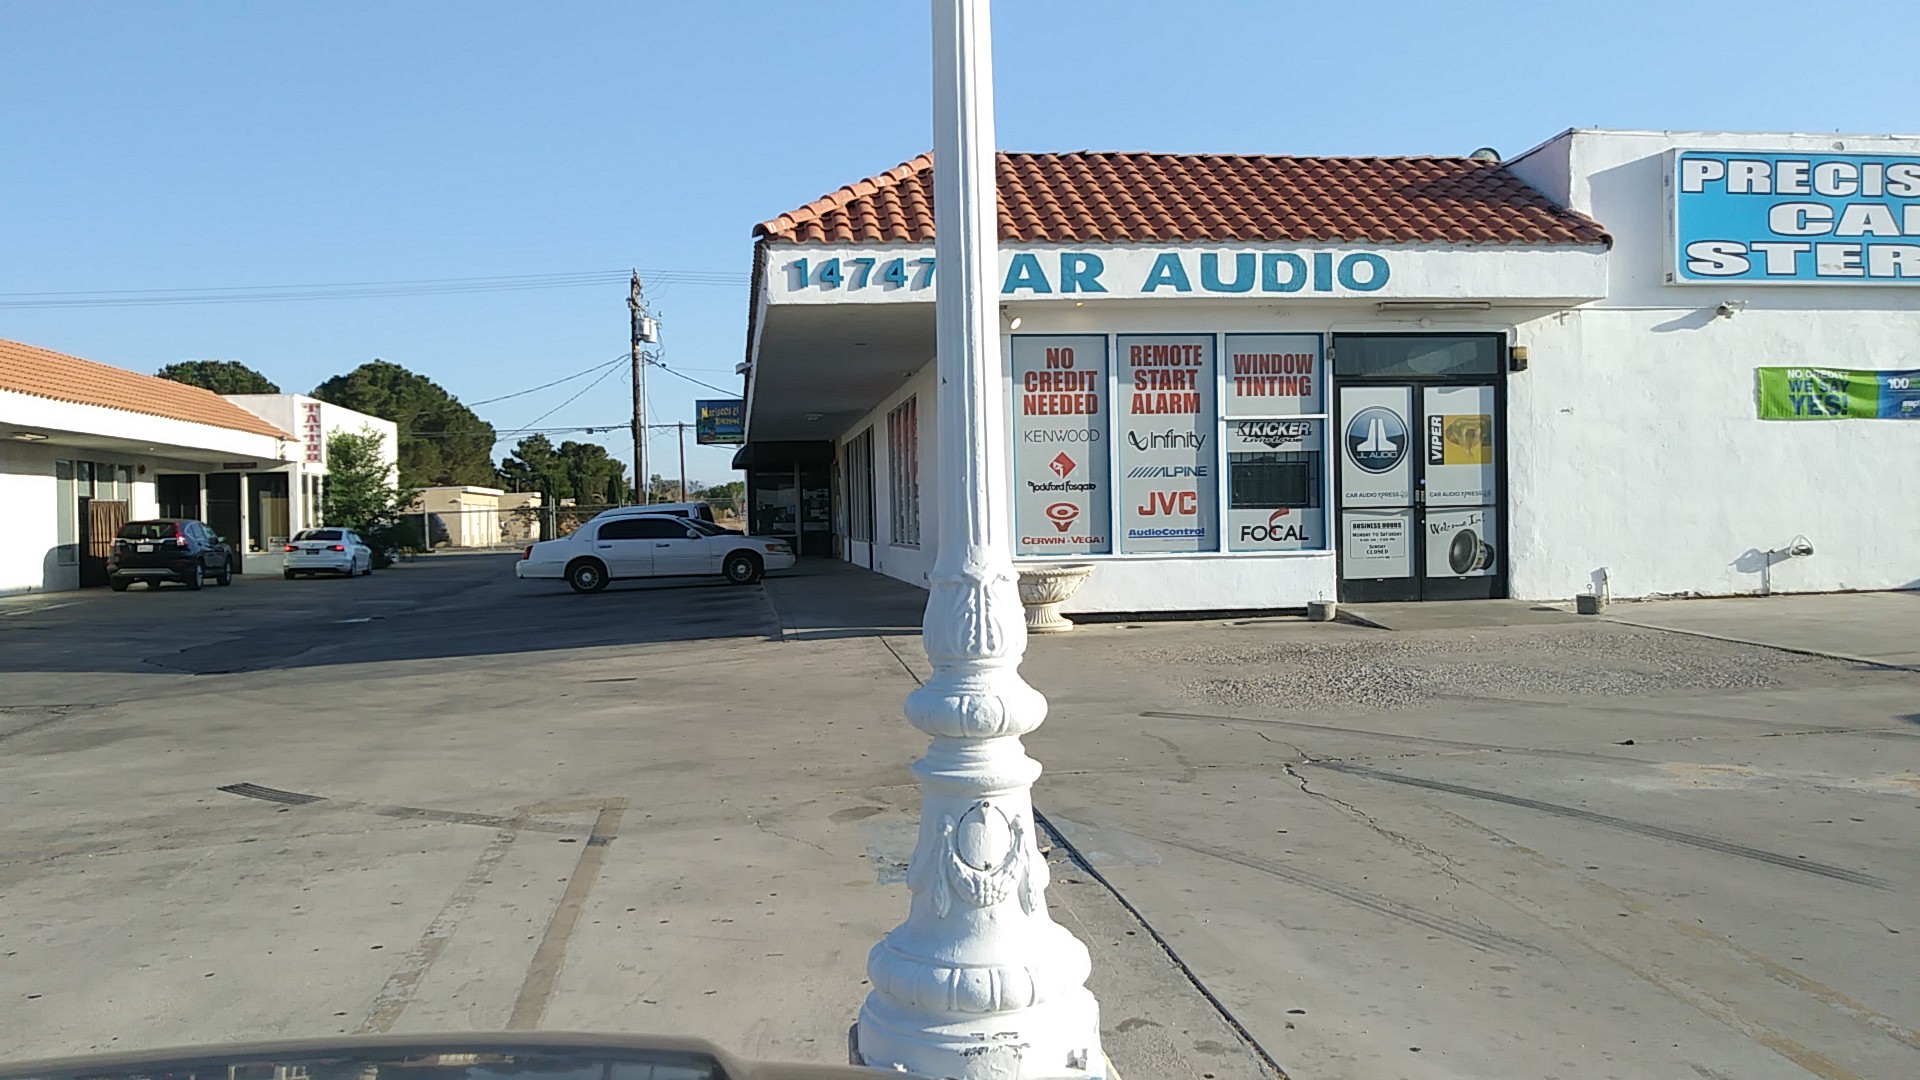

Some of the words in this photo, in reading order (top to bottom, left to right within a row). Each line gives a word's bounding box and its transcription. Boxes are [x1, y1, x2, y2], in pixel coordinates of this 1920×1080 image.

[1681, 158, 1920, 197] PRECIS
[794, 257, 936, 288] 14747
[1141, 253, 1391, 293] AUDIO
[1046, 347, 1074, 369] NO
[1130, 344, 1202, 366] REMOTE
[1233, 353, 1313, 374] WINDOW
[1024, 371, 1098, 392] CREDIT
[1134, 369, 1198, 391] START
[1787, 369, 1802, 379] NO
[1887, 378, 1910, 389] 100
[1233, 376, 1311, 396] TINTING
[1788, 379, 1814, 393] WE
[1817, 378, 1850, 393] SAY
[1023, 394, 1098, 415] NEEDED
[1131, 393, 1201, 414] ALARM
[1788, 394, 1849, 416] YES!
[1024, 429, 1100, 442] KENWOOD
[1150, 429, 1206, 451] Infinity
[1431, 417, 1443, 461] VIPER
[1152, 466, 1208, 478] ALPINE
[1138, 491, 1197, 516] JVC
[1128, 528, 1205, 536] AudioControl
[1240, 524, 1309, 541] FOCAL
